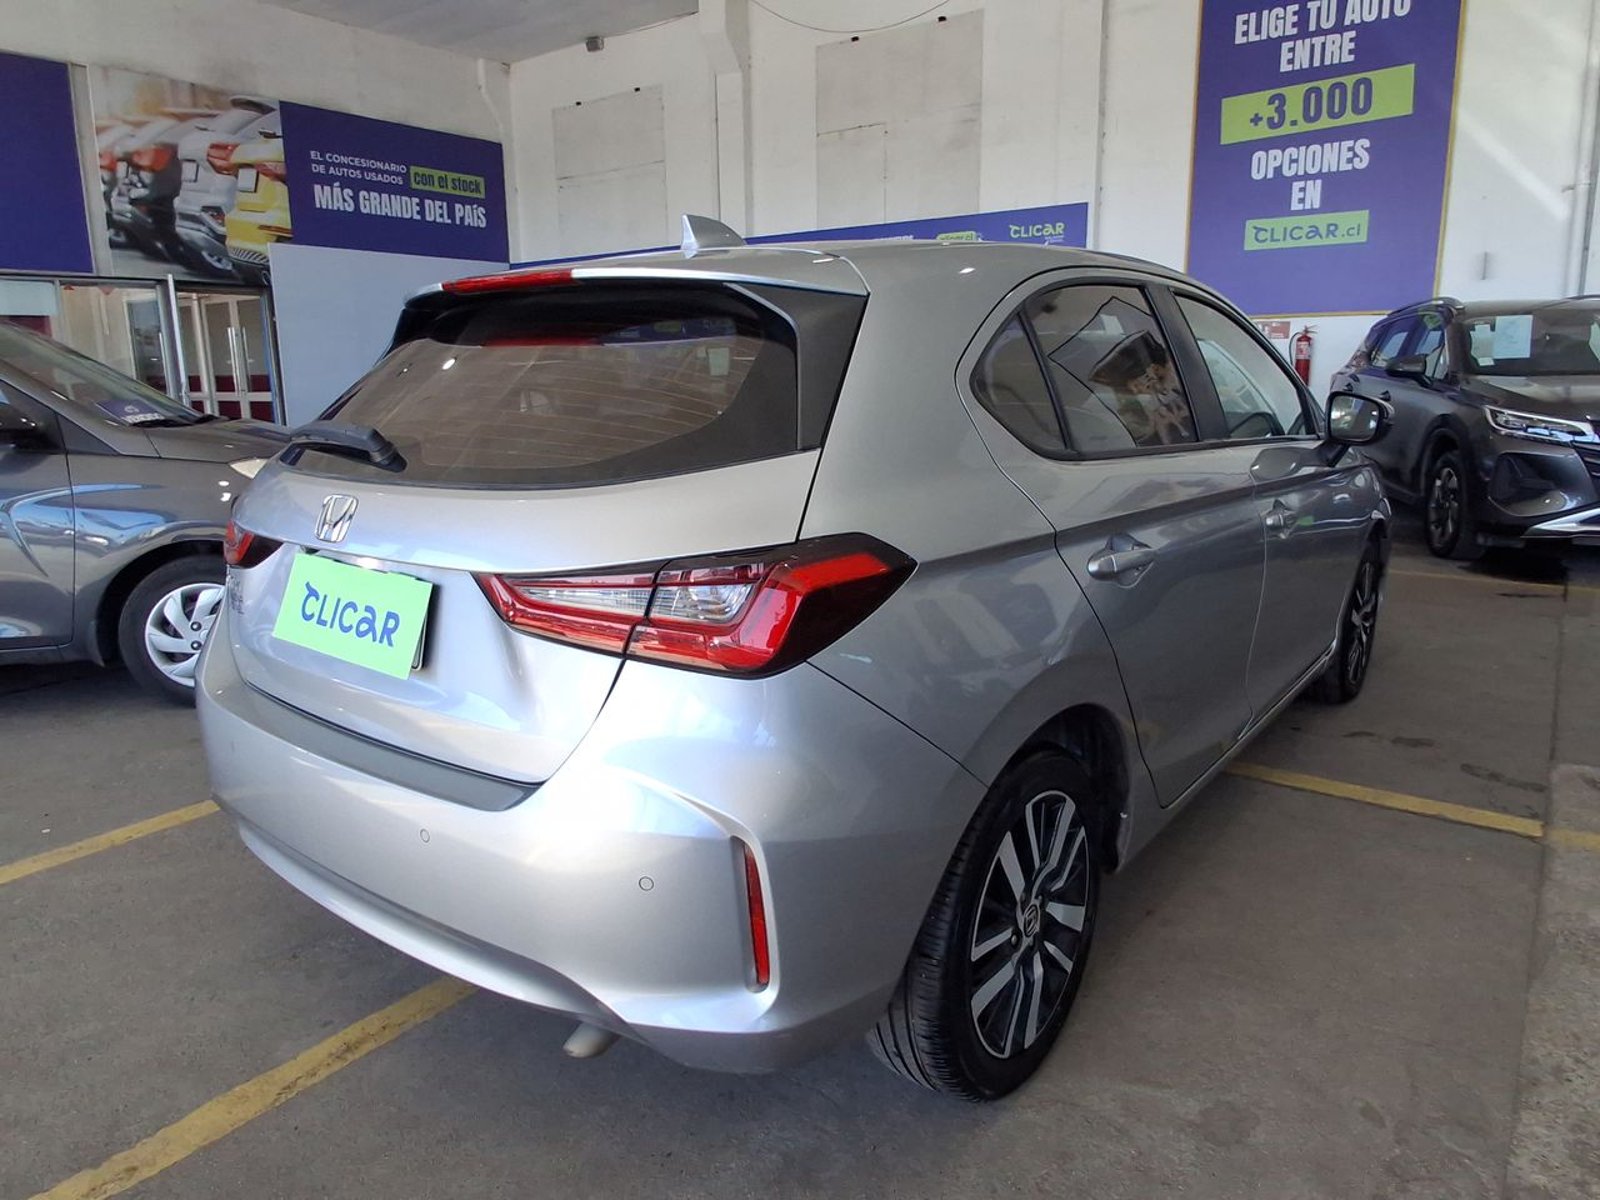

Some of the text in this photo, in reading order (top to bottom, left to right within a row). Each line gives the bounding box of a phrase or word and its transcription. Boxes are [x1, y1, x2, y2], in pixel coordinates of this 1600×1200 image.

[1235, 0, 1411, 45] ELIGE TU AUTO
[1280, 30, 1357, 73] ENTRE
[1250, 77, 1373, 130] +3.000
[310, 151, 407, 174] EL CONCESIONARIO
[311, 164, 404, 185] DE AUTOS USADOS
[1251, 138, 1371, 180] OPCIONES
[313, 182, 355, 213] MÁS
[359, 190, 422, 220] GRANDE
[424, 198, 452, 224] DEL
[413, 171, 482, 195] con el stock
[1290, 179, 1322, 211] EN
